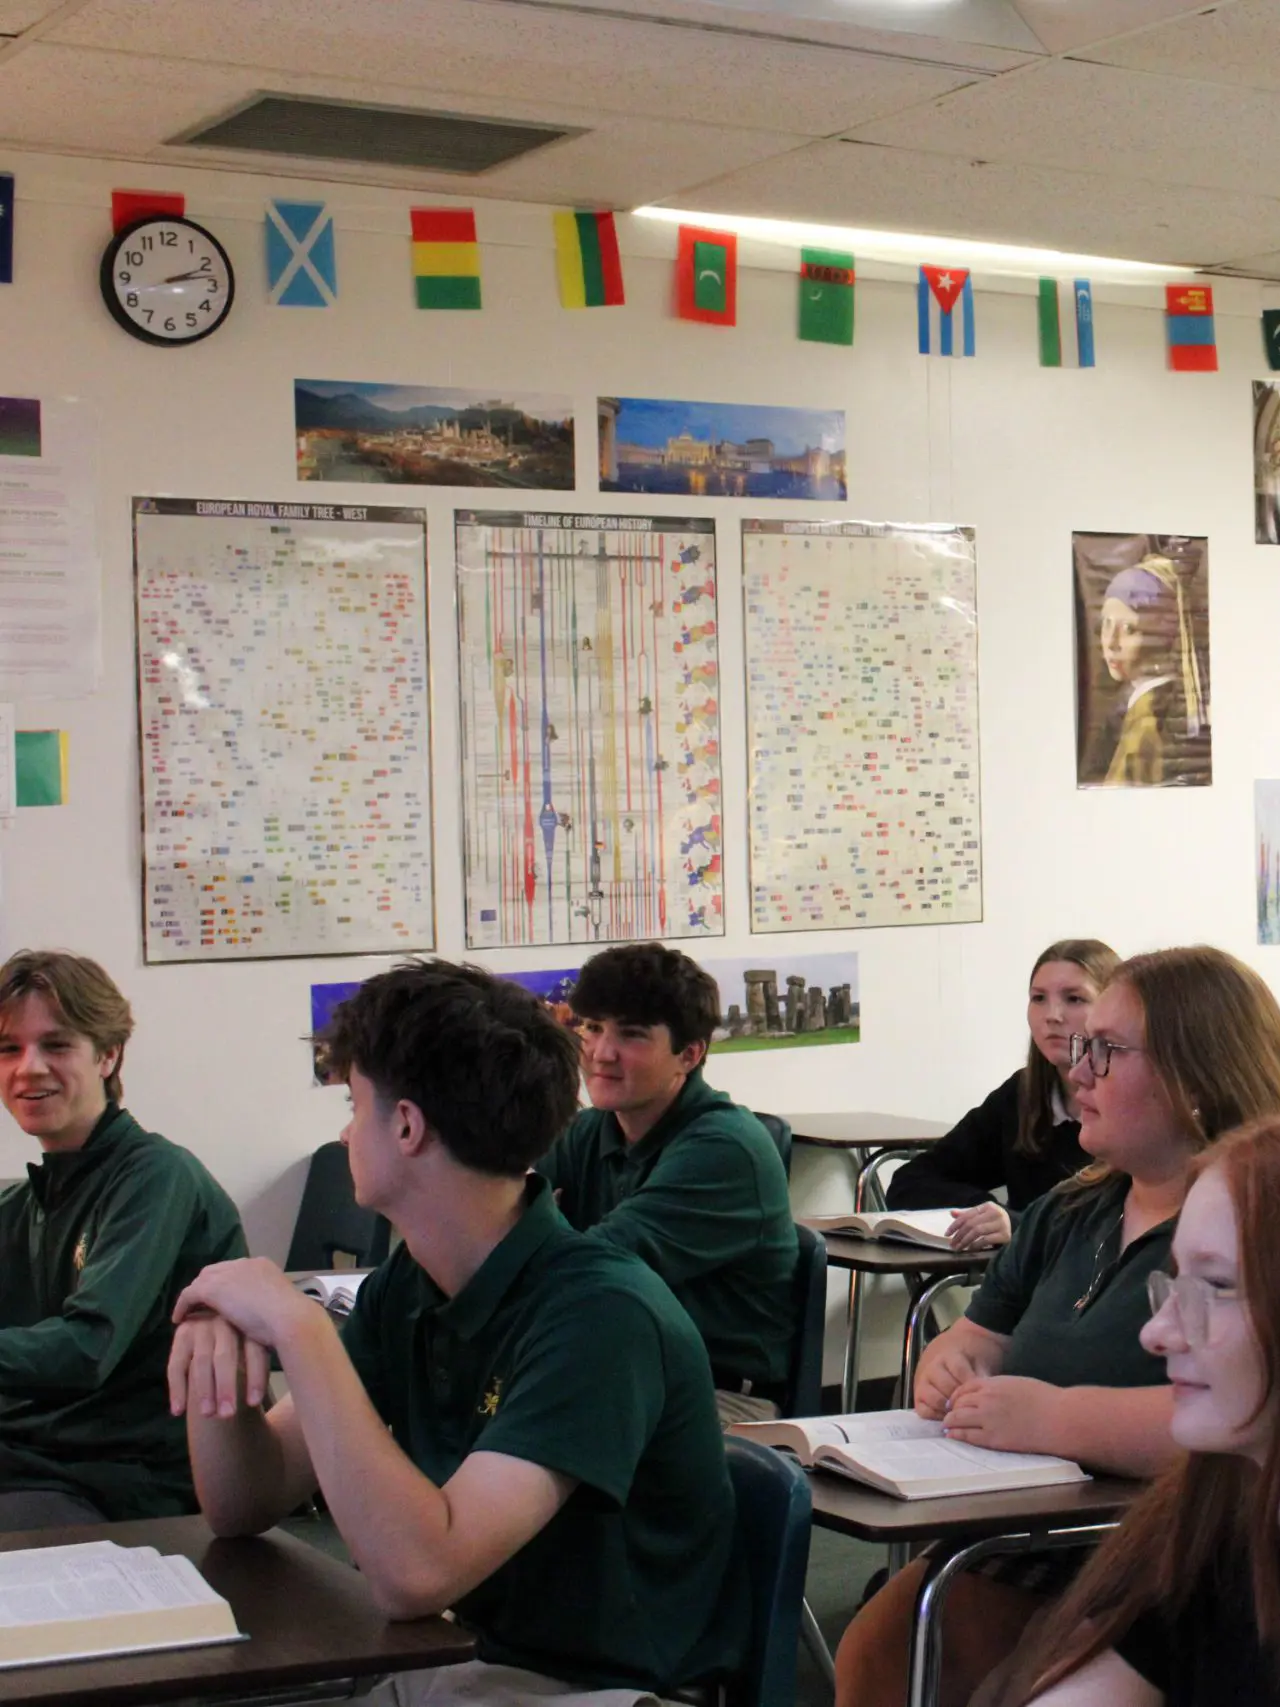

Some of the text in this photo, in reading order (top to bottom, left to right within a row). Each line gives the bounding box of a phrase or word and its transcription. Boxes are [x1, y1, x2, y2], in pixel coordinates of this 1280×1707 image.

[141, 235, 153, 251] 11
[159, 231, 178, 247] 12
[187, 239, 194, 254] 1
[125, 250, 144, 267] 10
[200, 256, 212, 272] 2
[118, 271, 131, 284] 9
[206, 278, 219, 293] 3
[126, 292, 139, 308] 8
[197, 299, 212, 313] 4
[141, 308, 155, 324] 7
[163, 316, 177, 331] 6
[185, 312, 198, 327] 5
[196, 501, 246, 516] EUROPEAN
[247, 503, 276, 518] ROYAL
[278, 505, 310, 518] FAMILY
[312, 507, 335, 519] TREE
[343, 507, 368, 520] WEST
[524, 514, 561, 528] TIMELINE
[562, 516, 573, 528] OF
[574, 516, 618, 530] EUROPEAN
